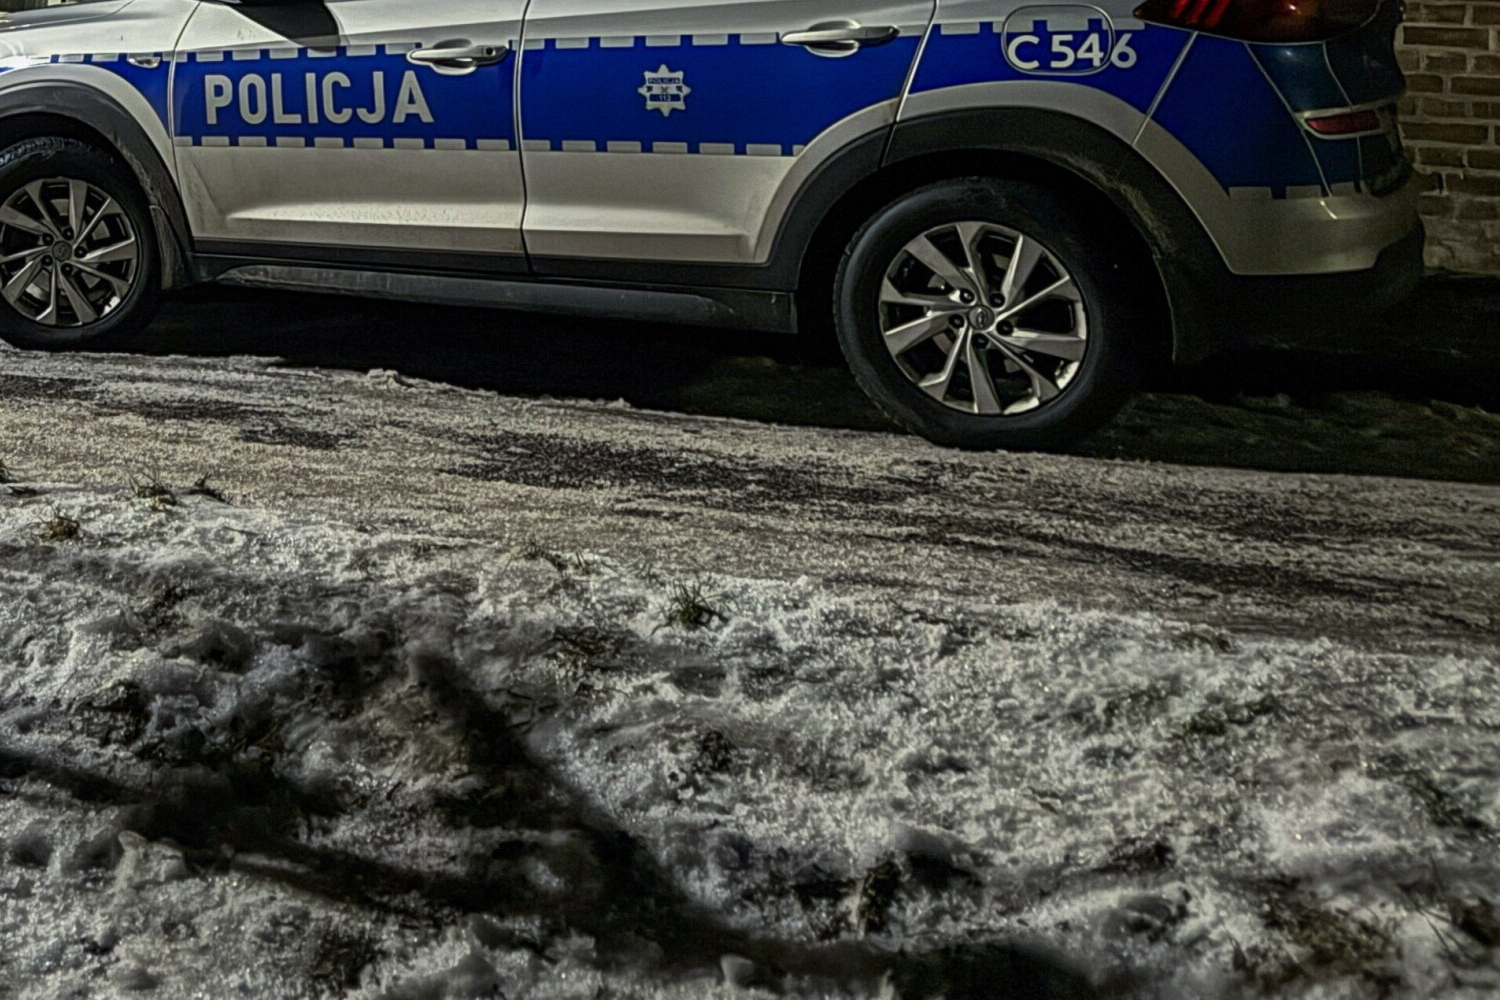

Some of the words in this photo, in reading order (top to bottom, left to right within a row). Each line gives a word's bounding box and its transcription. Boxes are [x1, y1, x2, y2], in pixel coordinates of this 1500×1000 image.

[1007, 34, 1040, 69] C
[1050, 32, 1137, 69] 546
[204, 70, 435, 125] POLICJA
